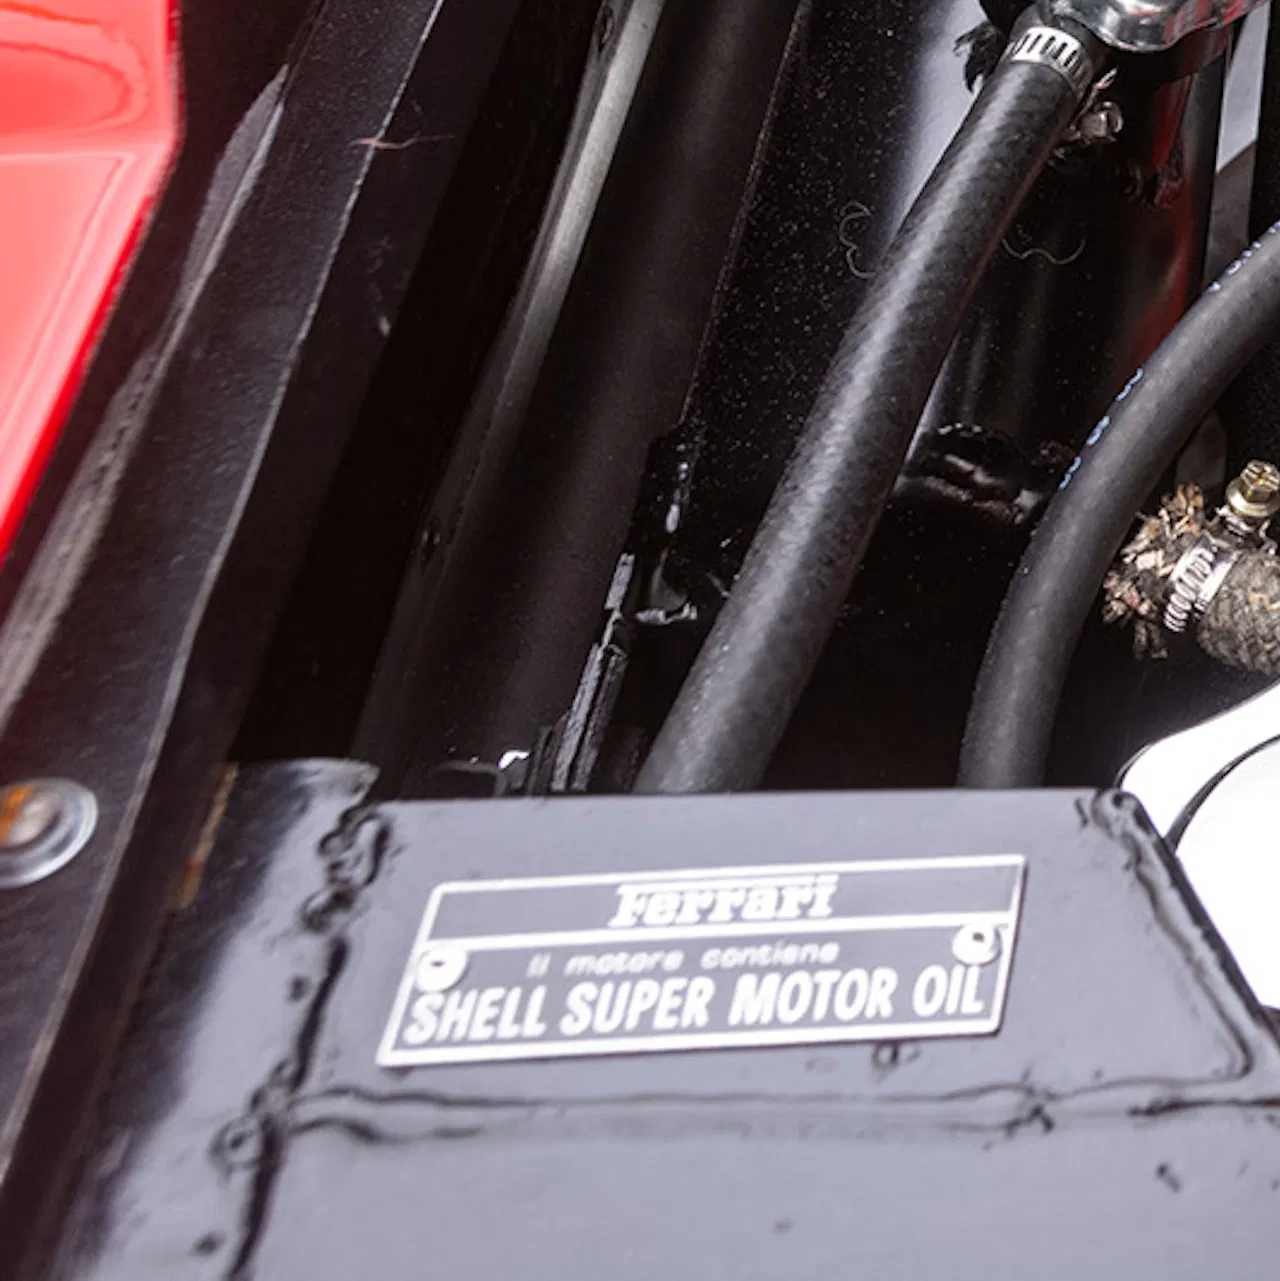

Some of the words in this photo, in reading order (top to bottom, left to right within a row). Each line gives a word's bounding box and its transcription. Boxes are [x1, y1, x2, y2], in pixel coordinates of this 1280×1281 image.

[611, 875, 838, 926] Ferrari
[563, 949, 685, 977] motore
[700, 939, 840, 971] contiene
[406, 986, 546, 1044] SHELL
[560, 976, 716, 1036] SUPER
[728, 967, 897, 1026] MOTOR
[912, 963, 985, 1017] OIL
